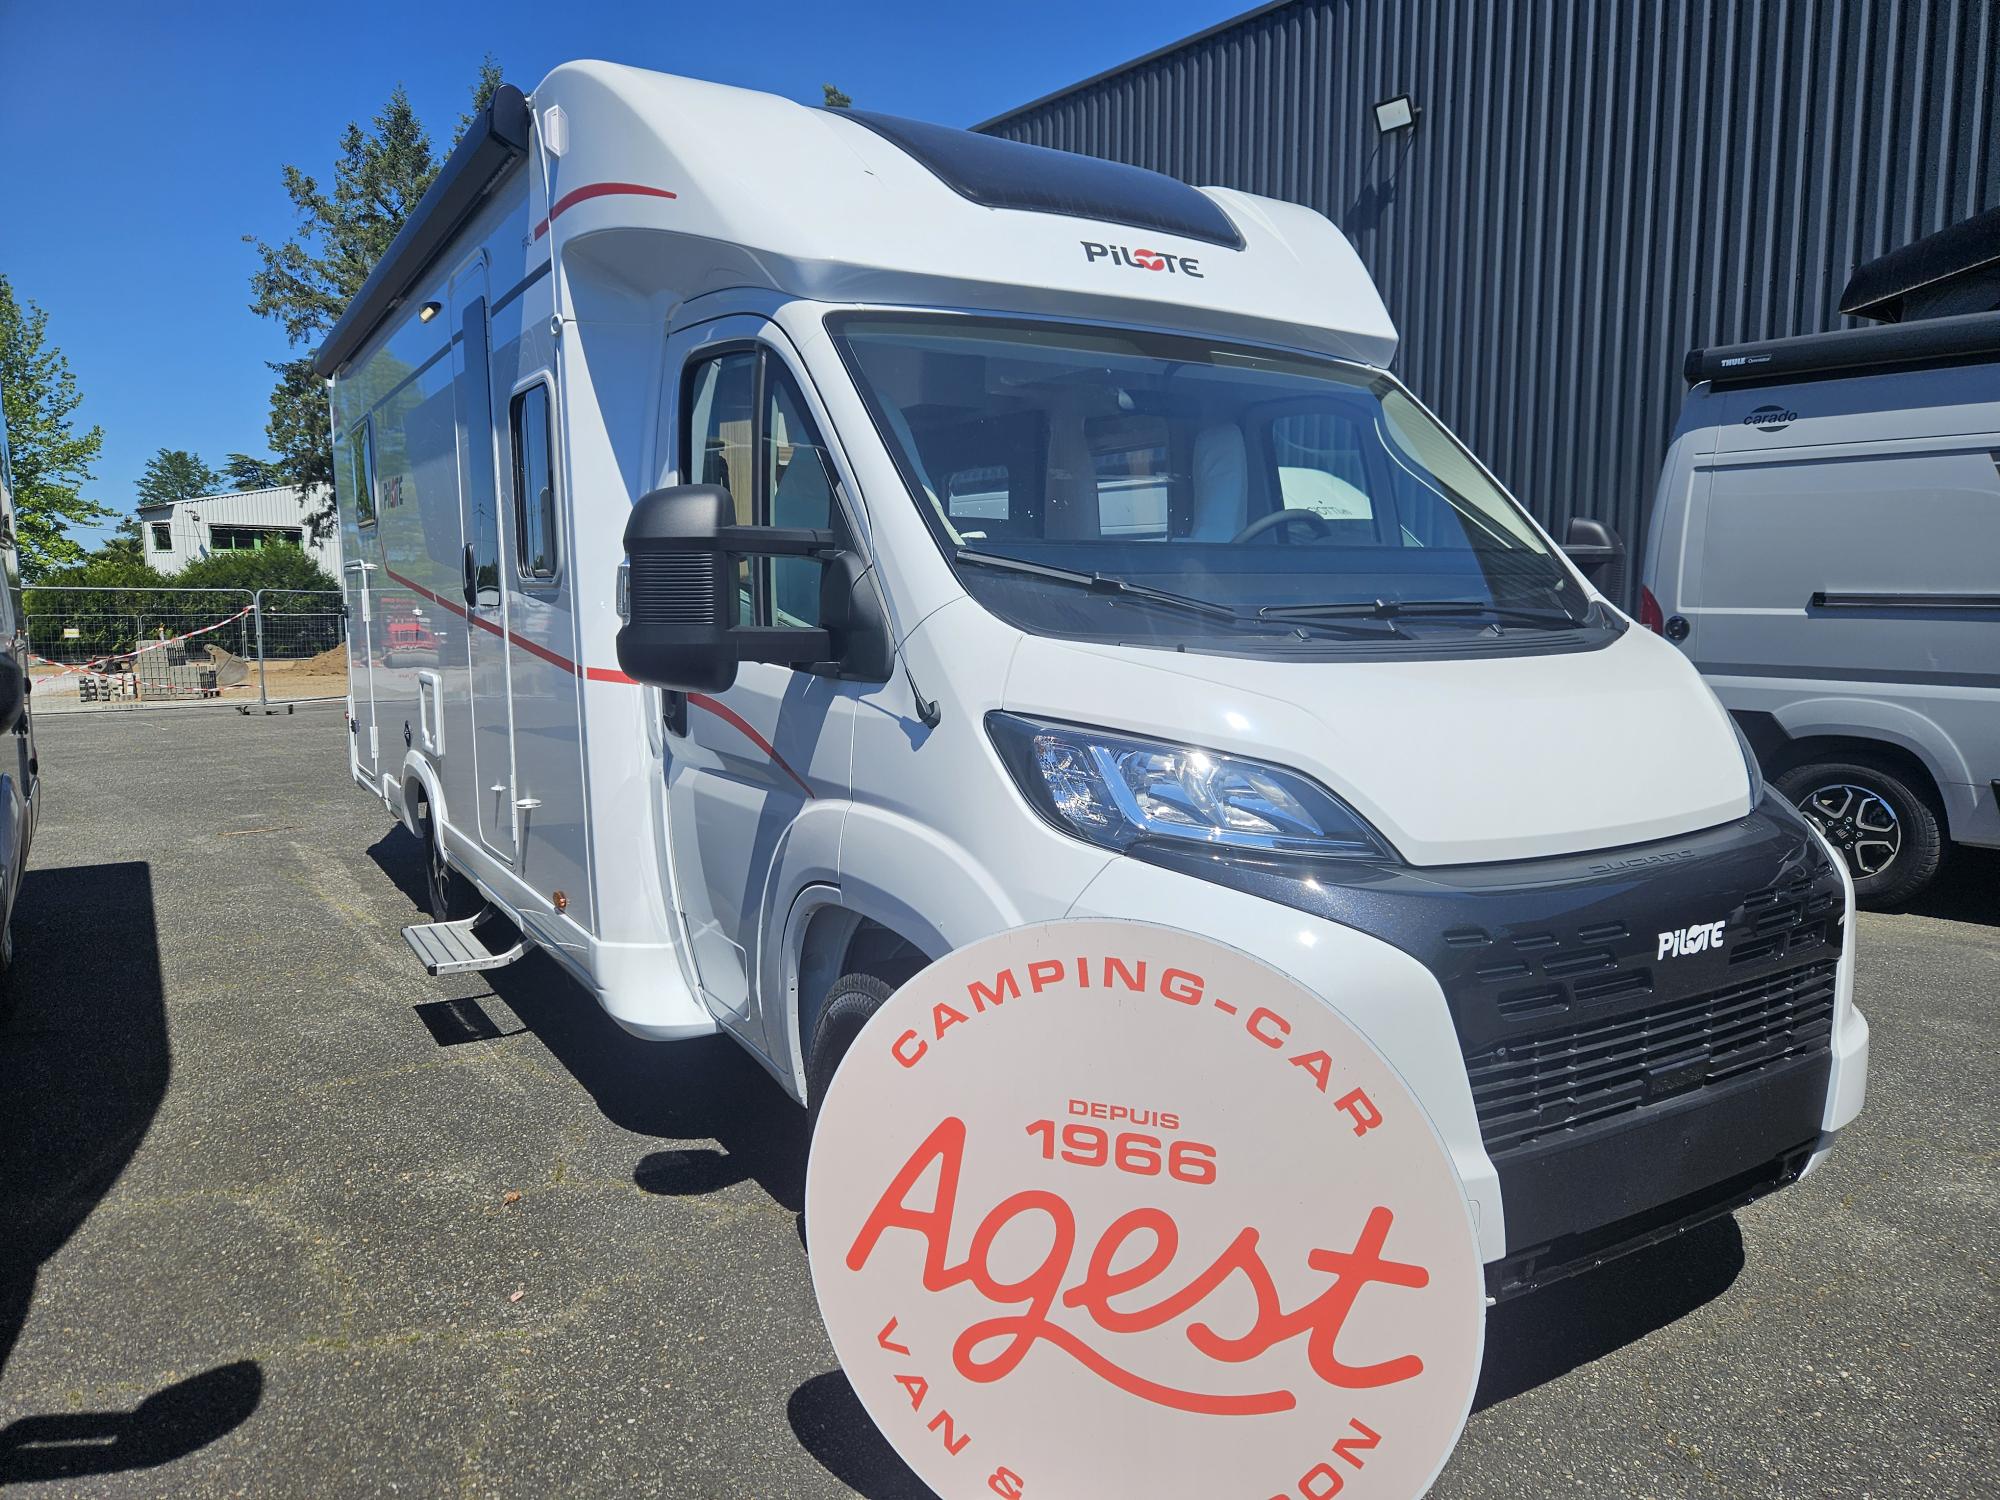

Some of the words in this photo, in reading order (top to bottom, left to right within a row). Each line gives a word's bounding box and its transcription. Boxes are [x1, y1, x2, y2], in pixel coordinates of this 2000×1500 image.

[1721, 357, 1746, 367] THULE
[1743, 410, 1798, 426] carado
[1588, 849, 1696, 874] DUCATO
[892, 957, 1383, 1137] CAMPING-CAR
[1068, 1099, 1180, 1130] DEPUIS
[1026, 1119, 1217, 1185] 1966
[845, 1116, 1430, 1416] Agest
